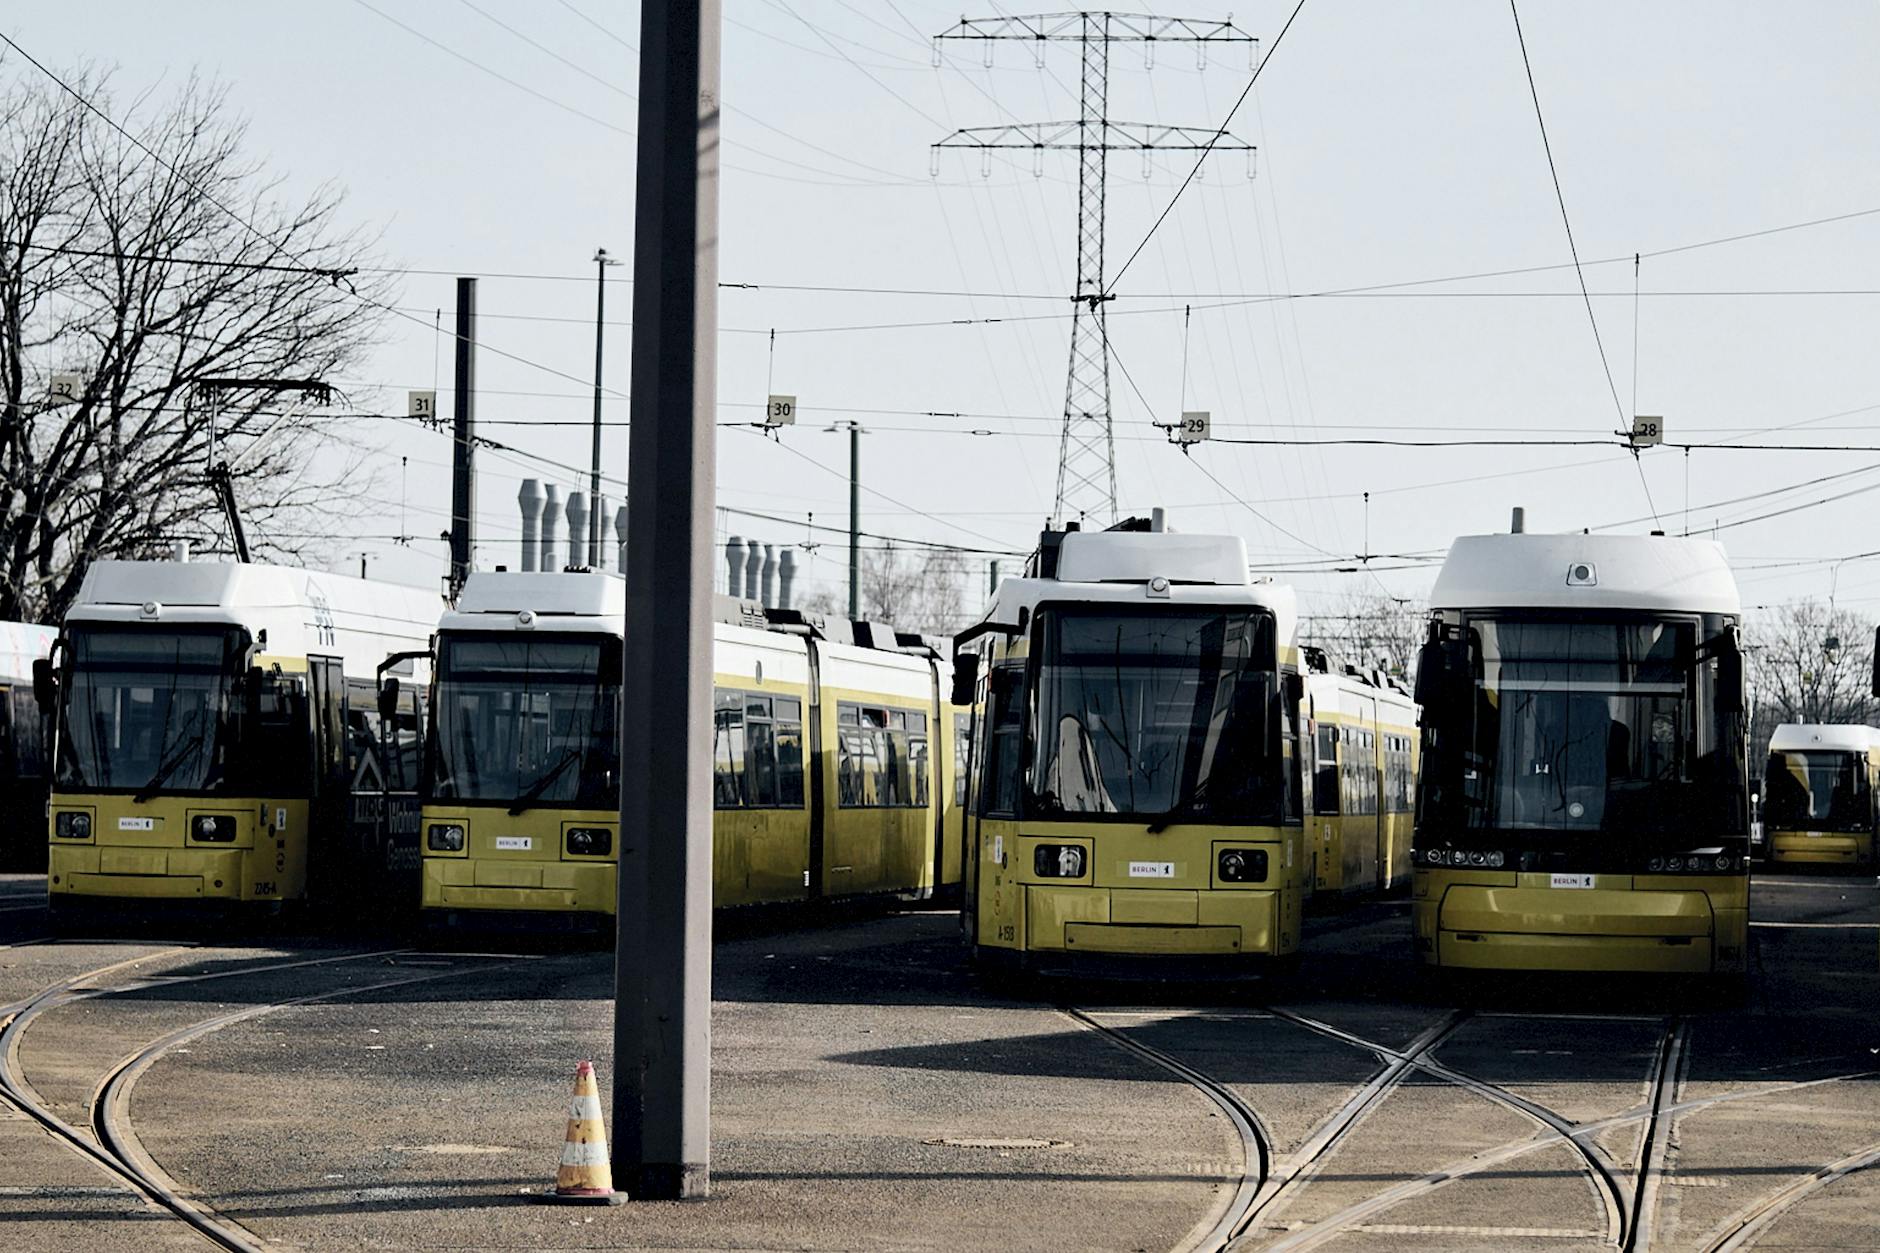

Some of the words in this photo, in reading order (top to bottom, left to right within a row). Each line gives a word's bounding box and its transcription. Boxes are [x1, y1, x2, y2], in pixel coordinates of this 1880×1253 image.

[57, 383, 72, 396] 32
[415, 398, 429, 411] 31
[774, 403, 791, 416] 30
[1187, 419, 1204, 433] 29
[1640, 423, 1657, 437] 28
